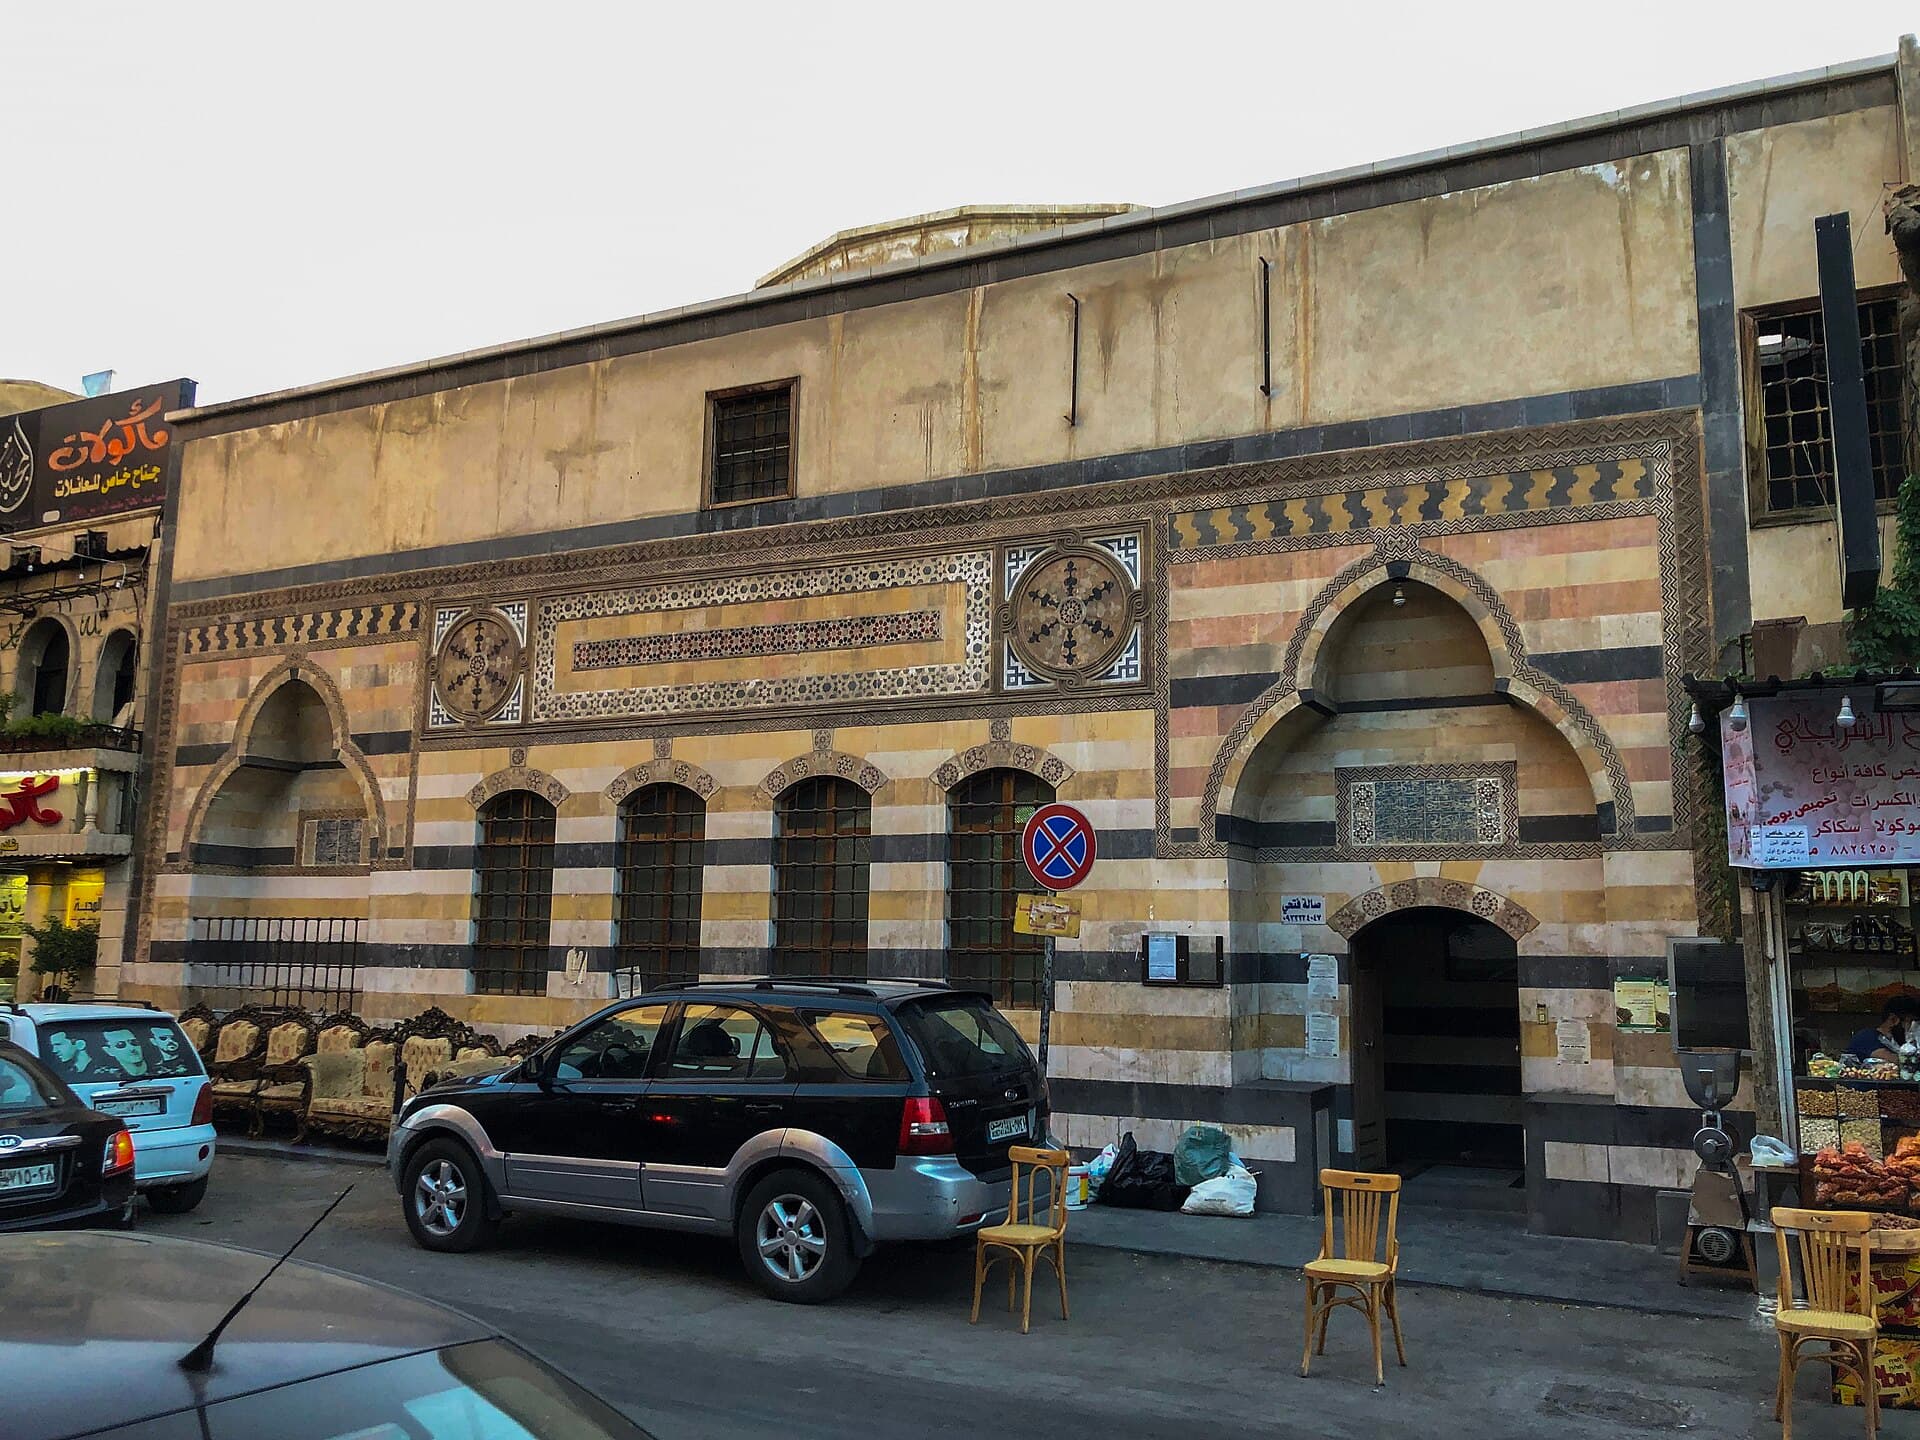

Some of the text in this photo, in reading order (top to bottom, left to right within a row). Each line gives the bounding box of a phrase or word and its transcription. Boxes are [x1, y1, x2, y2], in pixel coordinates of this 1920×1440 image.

[54, 463, 161, 497] جناح خاص للعائلات
[1853, 763, 1887, 779] كافة
[1811, 819, 1861, 838] سكاكر
